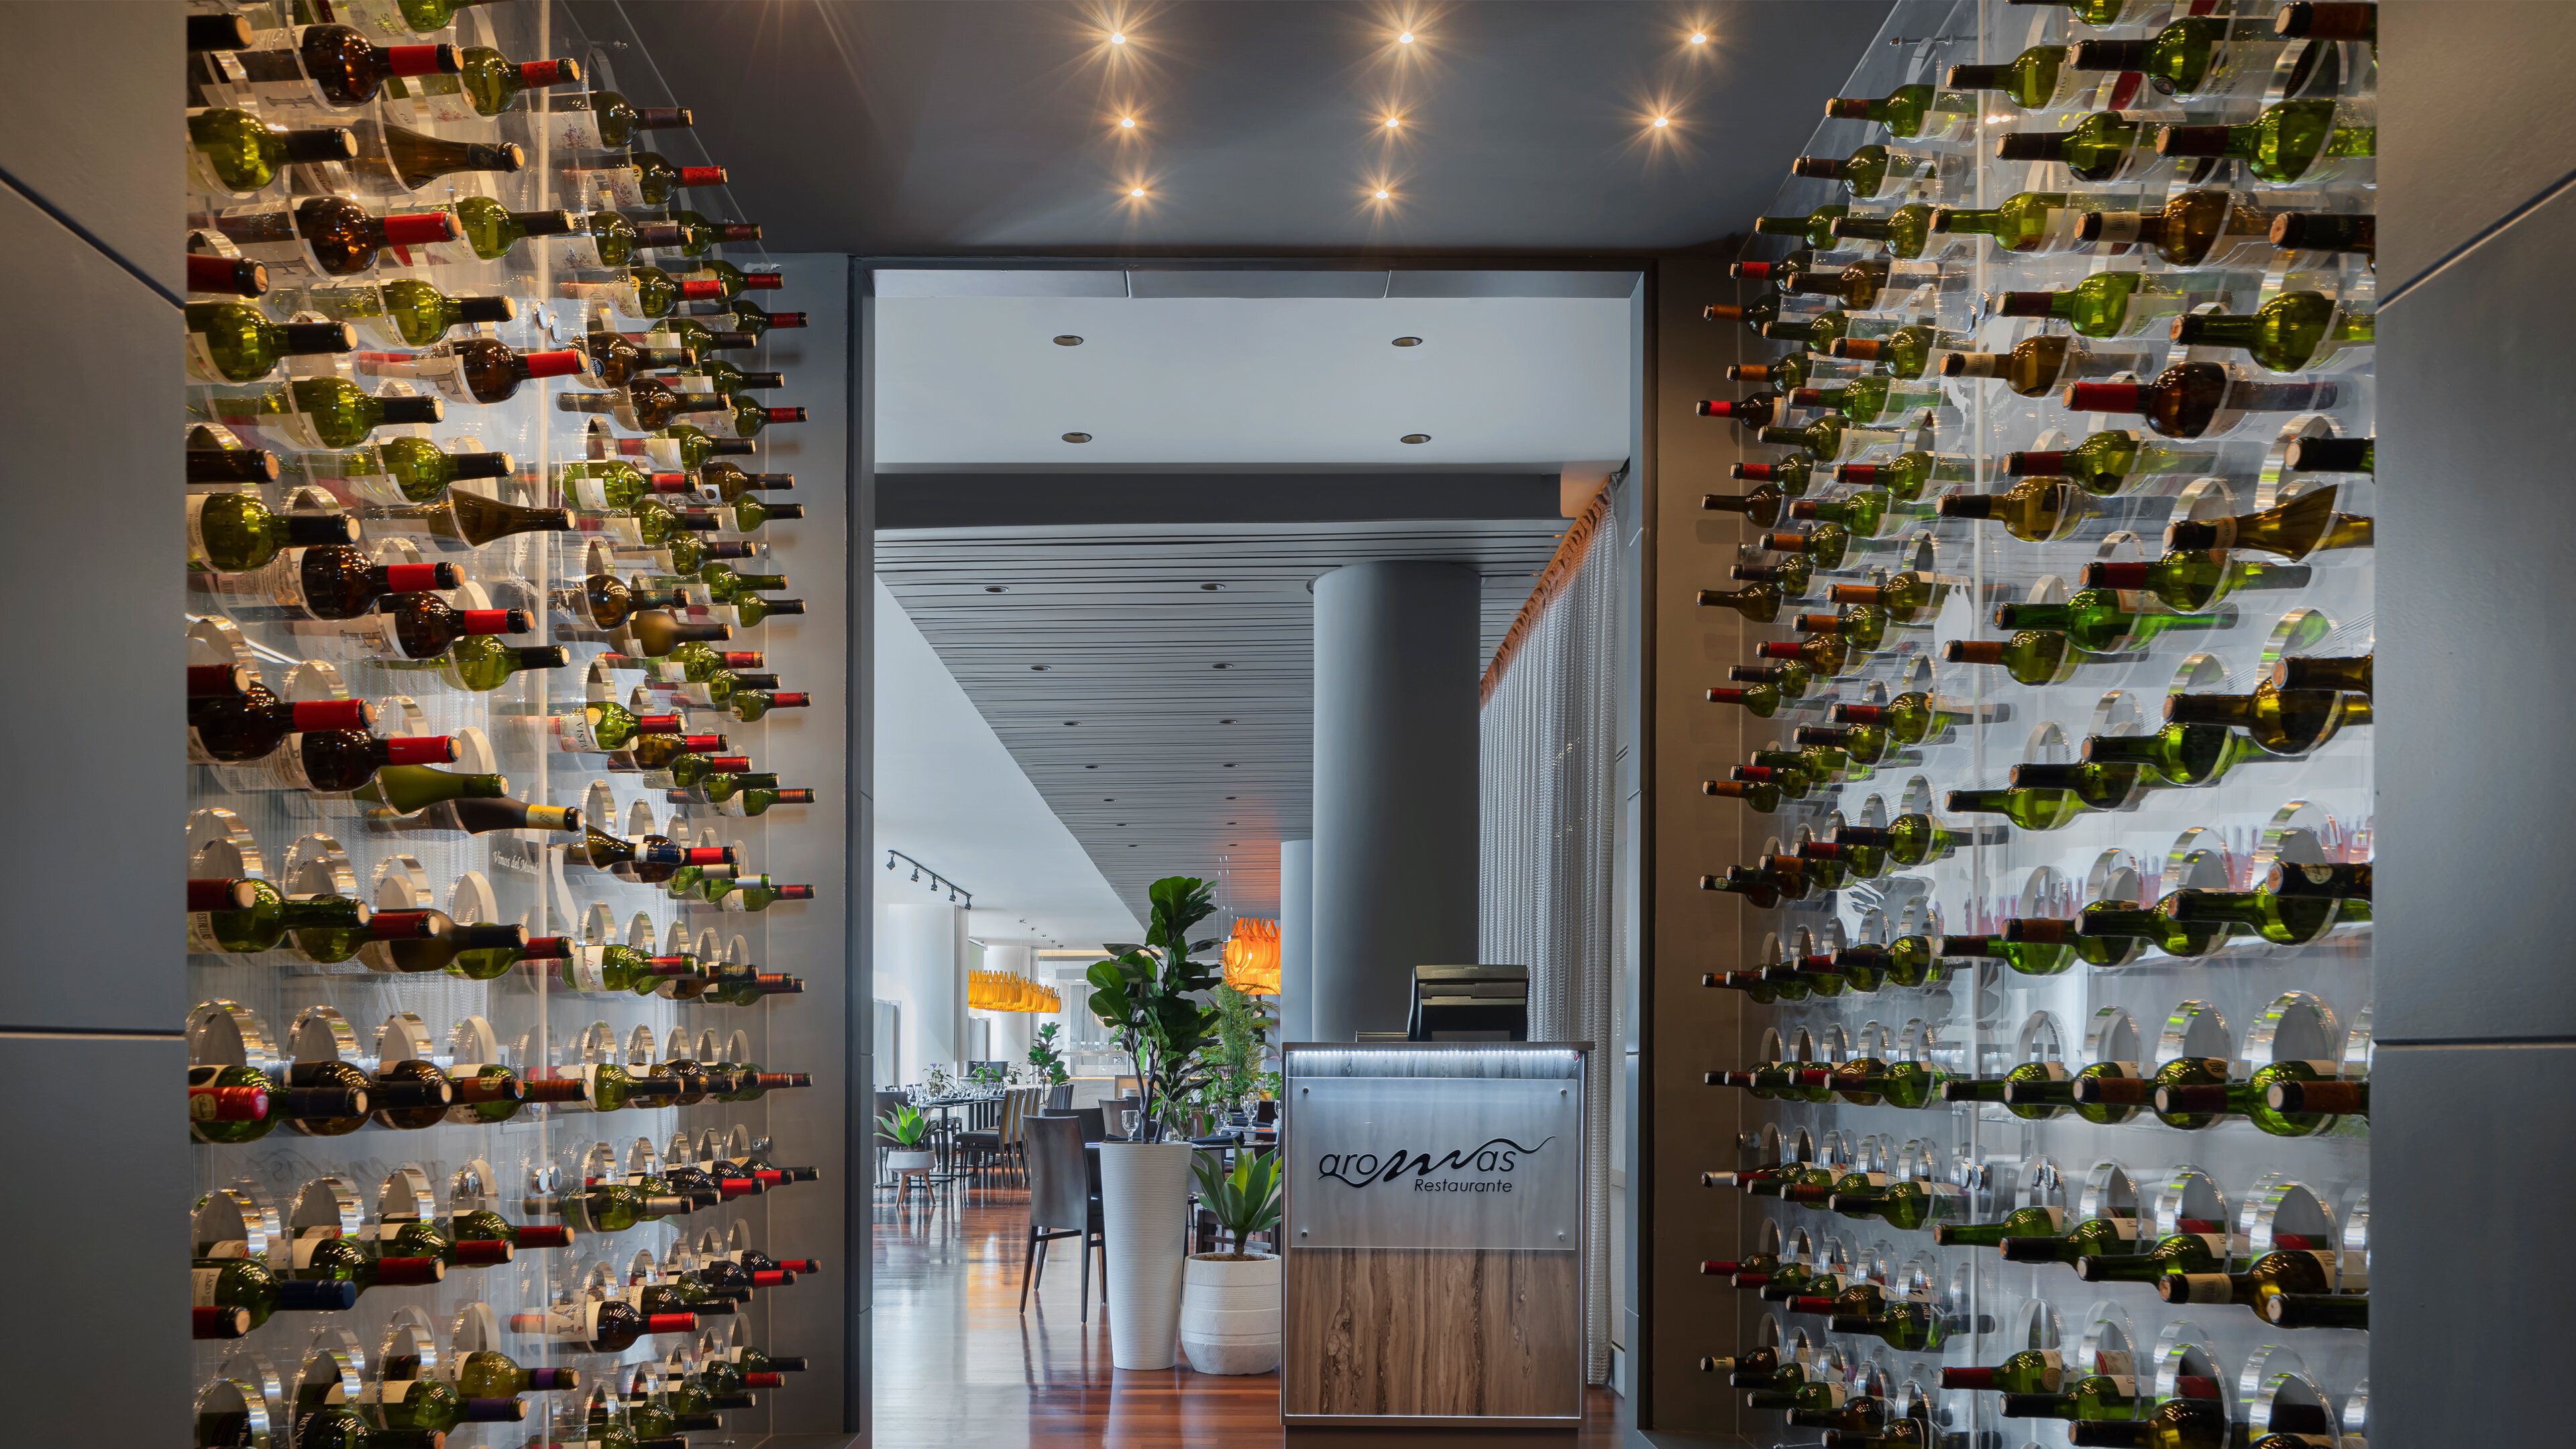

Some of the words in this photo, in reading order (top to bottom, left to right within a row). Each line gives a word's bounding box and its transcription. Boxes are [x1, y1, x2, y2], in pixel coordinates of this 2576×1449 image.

[508, 570, 539, 599] ARGENTINA
[511, 855, 521, 870] del
[196, 913, 214, 940] ESTRELLAS
[1318, 1135, 1556, 1189] aromas
[1414, 1178, 1513, 1193] Restaurante
[205, 1273, 216, 1295] LAZO
